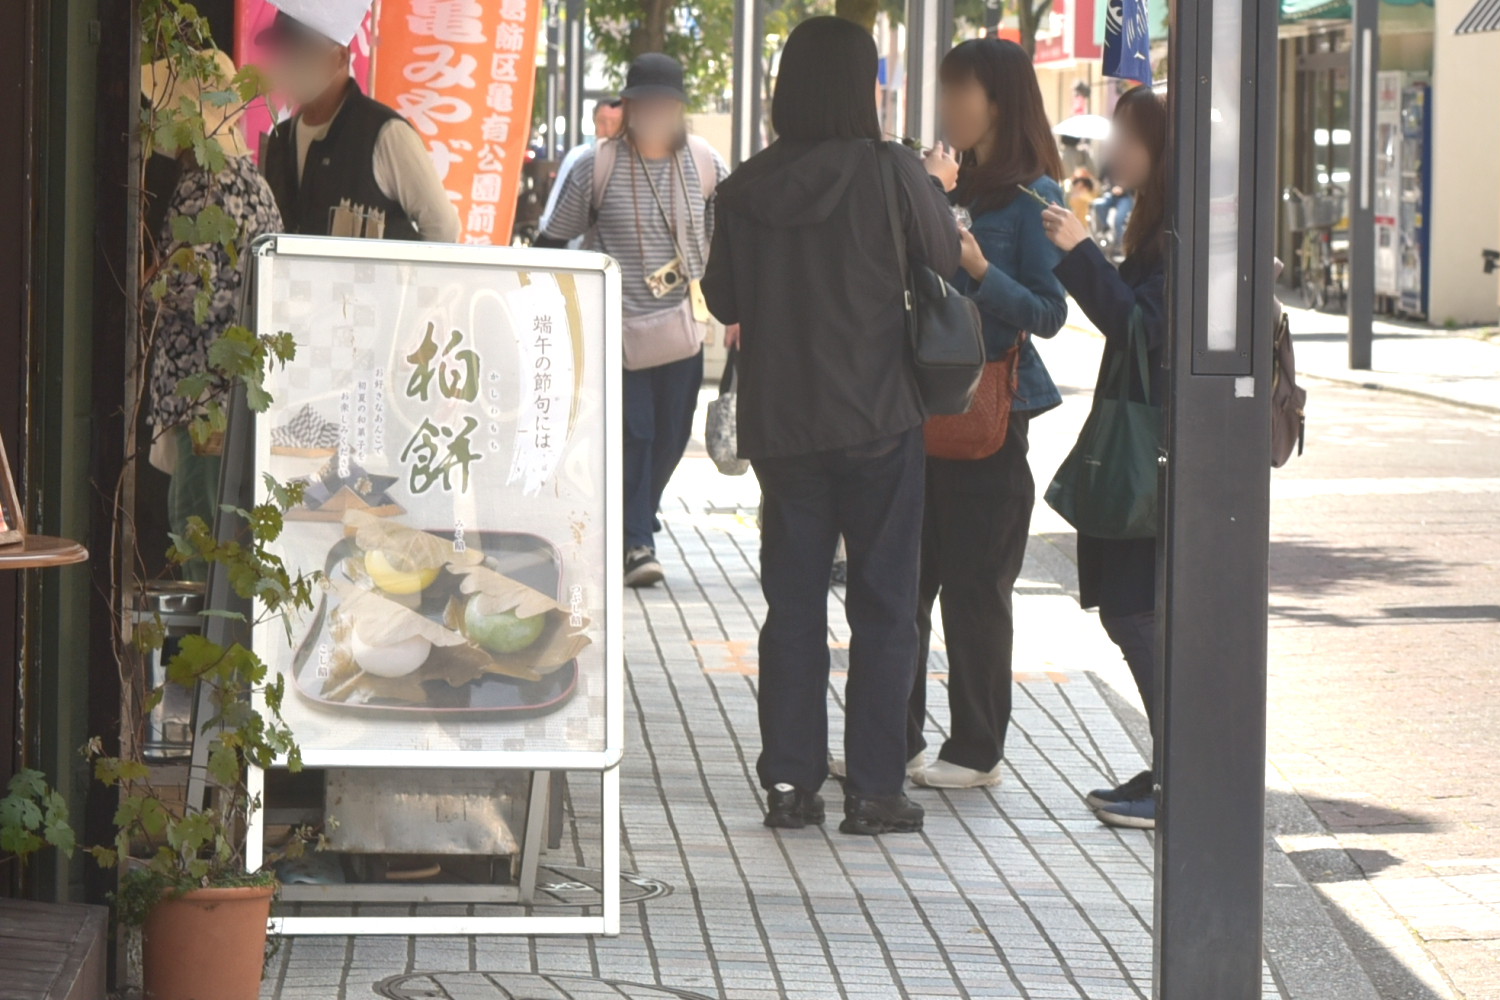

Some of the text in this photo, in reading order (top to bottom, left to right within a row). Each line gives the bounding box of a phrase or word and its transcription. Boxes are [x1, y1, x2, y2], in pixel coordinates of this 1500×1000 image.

[357, 381, 367, 461] 初夏の和菓子を
[374, 368, 384, 455] お好きなあんこで
[401, 321, 483, 495] 柏餅
[490, 372, 499, 450] かしわもち
[533, 315, 553, 449] 端午の節句には
[339, 391, 350, 477] お楽しみください
